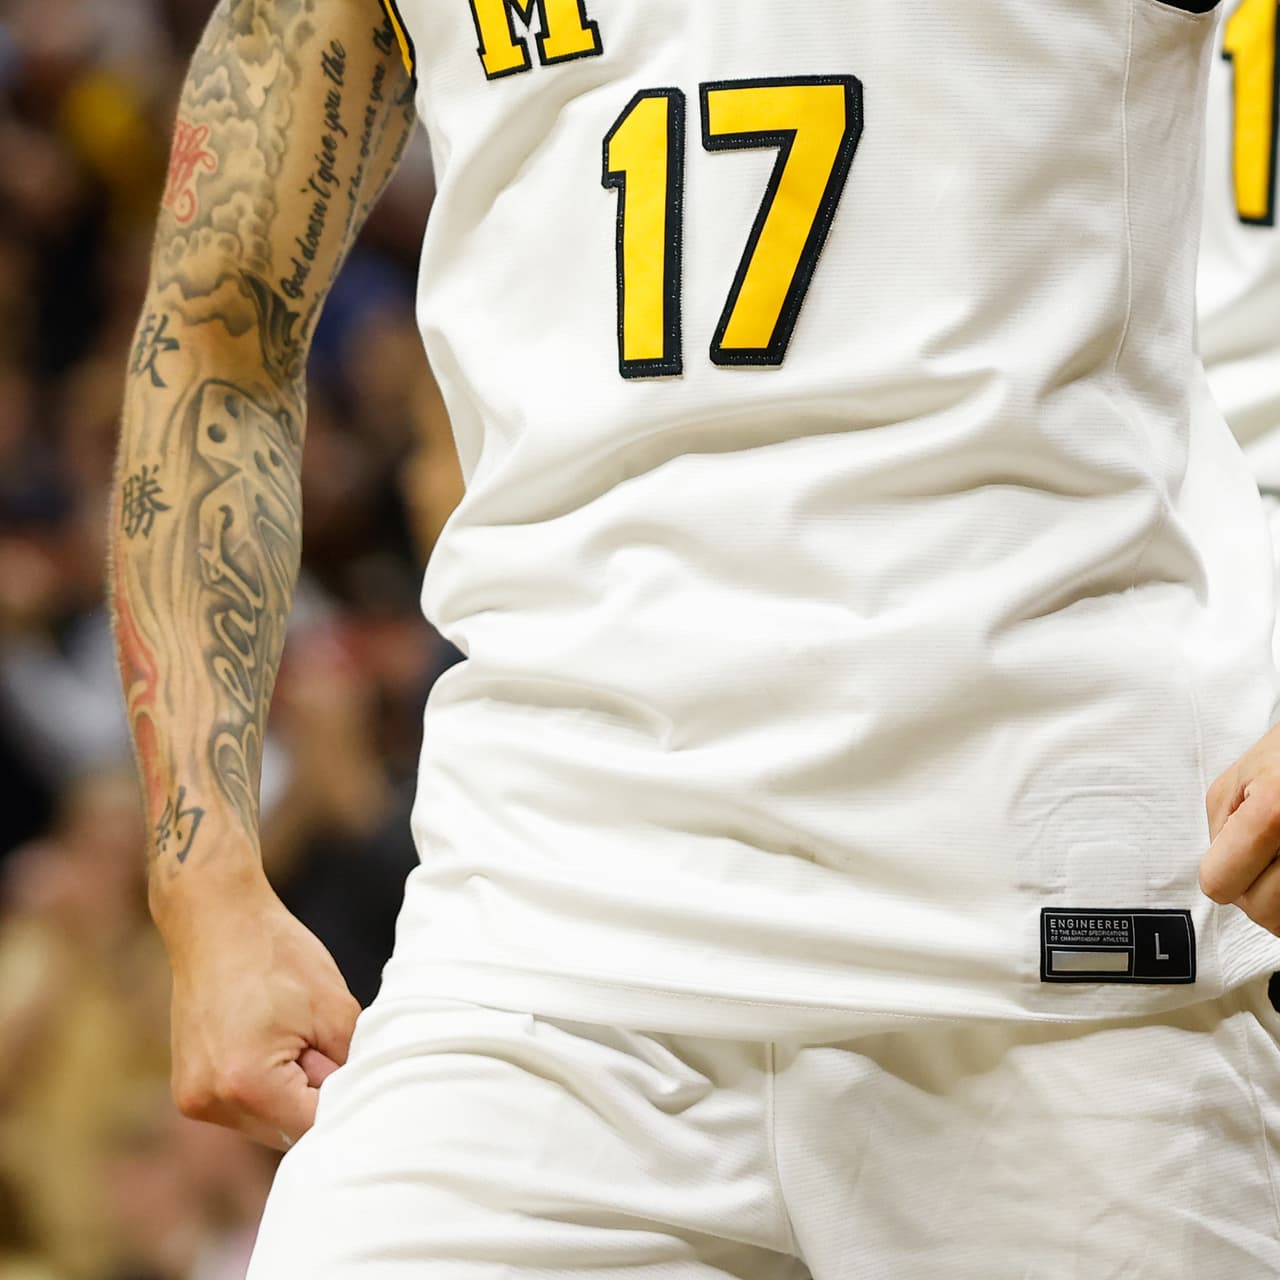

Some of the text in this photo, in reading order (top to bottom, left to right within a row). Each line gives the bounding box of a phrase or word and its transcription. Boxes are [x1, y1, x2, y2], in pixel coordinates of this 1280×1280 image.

[324, 88, 348, 139] you
[602, 74, 864, 380] 17
[1049, 919, 1129, 930] ENGINEERED
[1154, 932, 1169, 960] L
